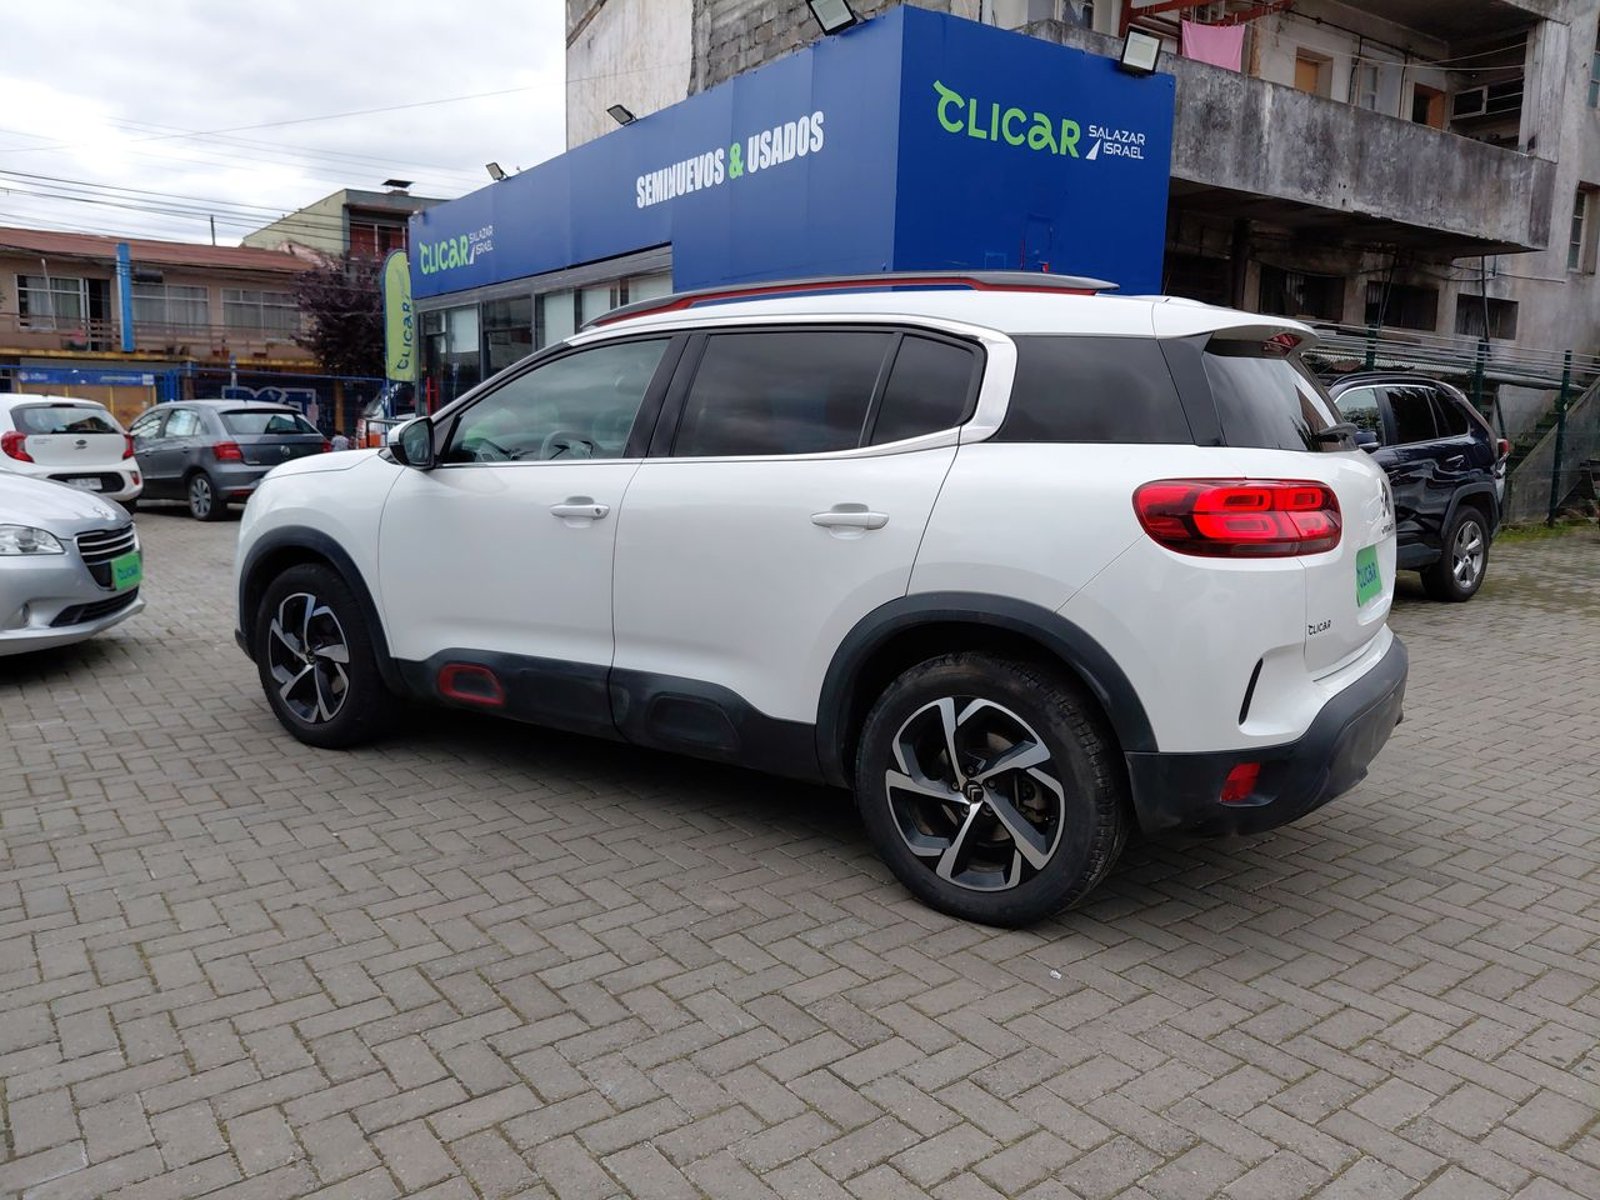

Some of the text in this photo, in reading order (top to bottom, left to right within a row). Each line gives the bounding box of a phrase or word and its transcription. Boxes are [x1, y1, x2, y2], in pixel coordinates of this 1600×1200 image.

[1088, 125, 1146, 146] SALAZAR
[636, 110, 825, 209] SEMINUEVOS & USADOS
[1103, 141, 1145, 160] ISRAEL
